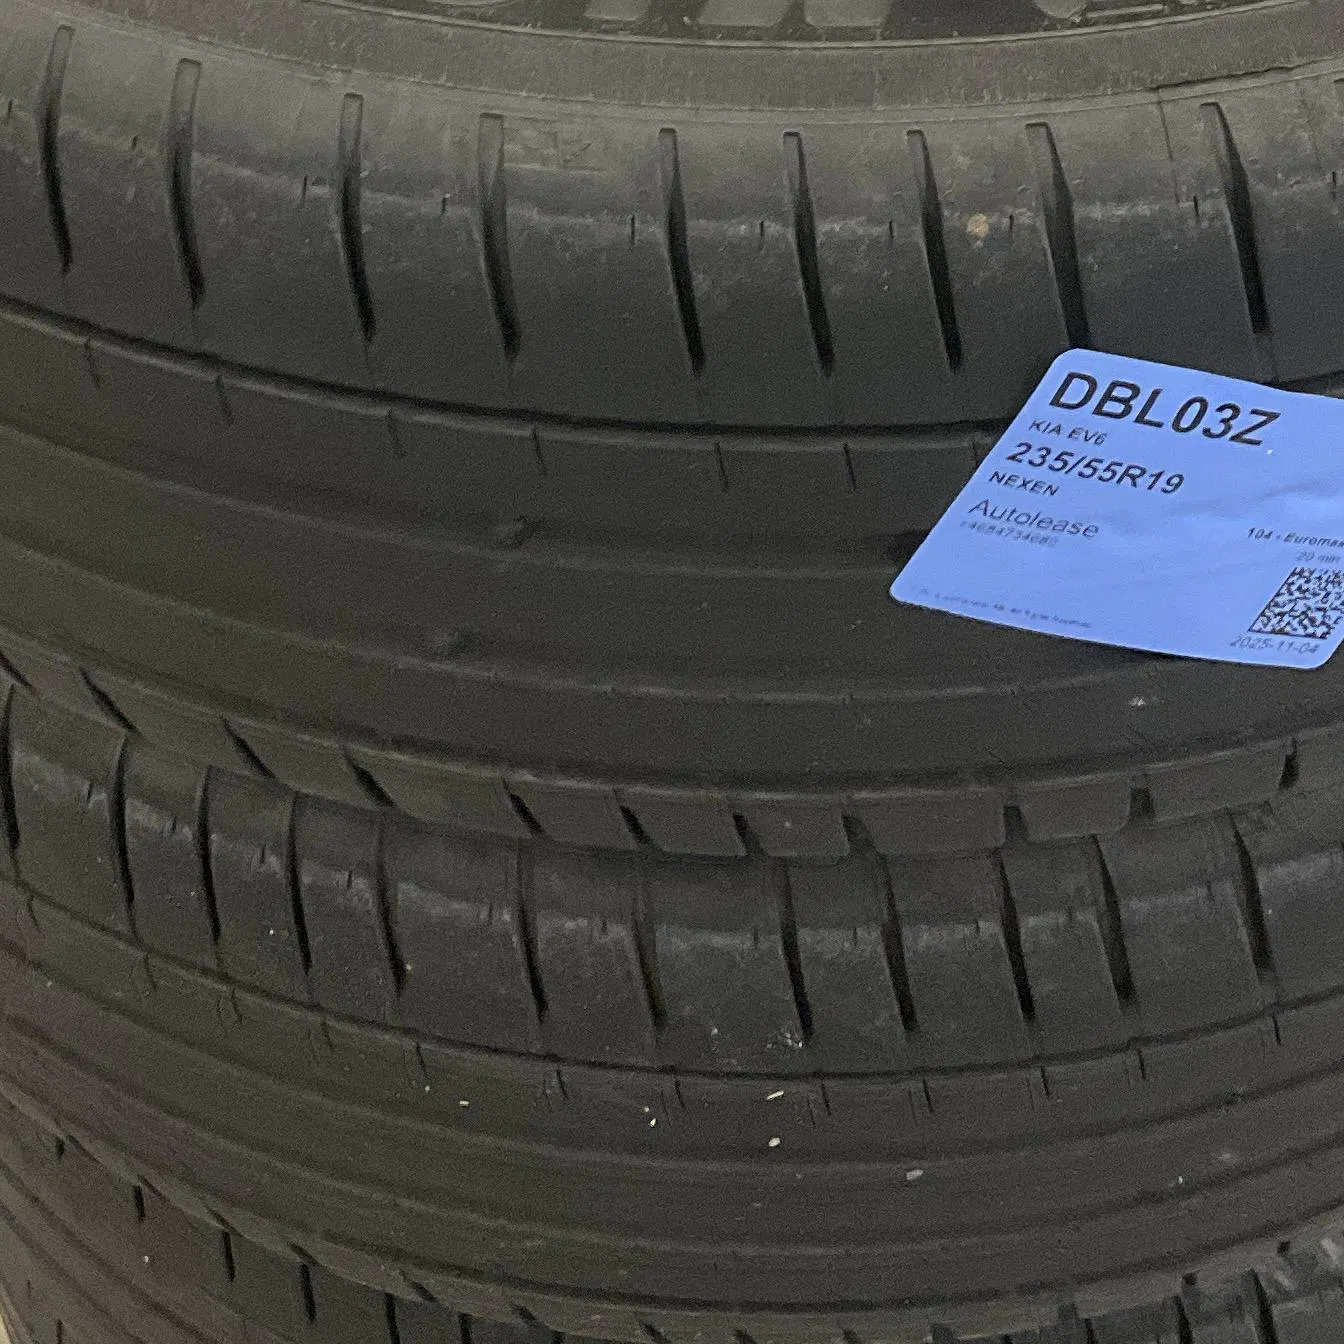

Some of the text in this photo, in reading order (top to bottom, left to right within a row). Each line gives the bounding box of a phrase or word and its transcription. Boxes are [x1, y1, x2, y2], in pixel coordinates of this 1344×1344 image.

[1049, 371, 1282, 446] DBL03Z
[1028, 419, 1108, 446] KIA EV6
[988, 470, 1061, 496] NEXEN
[1006, 441, 1185, 494] 235/55R19
[968, 499, 1099, 538] Autolease
[1247, 527, 1273, 540] 104
